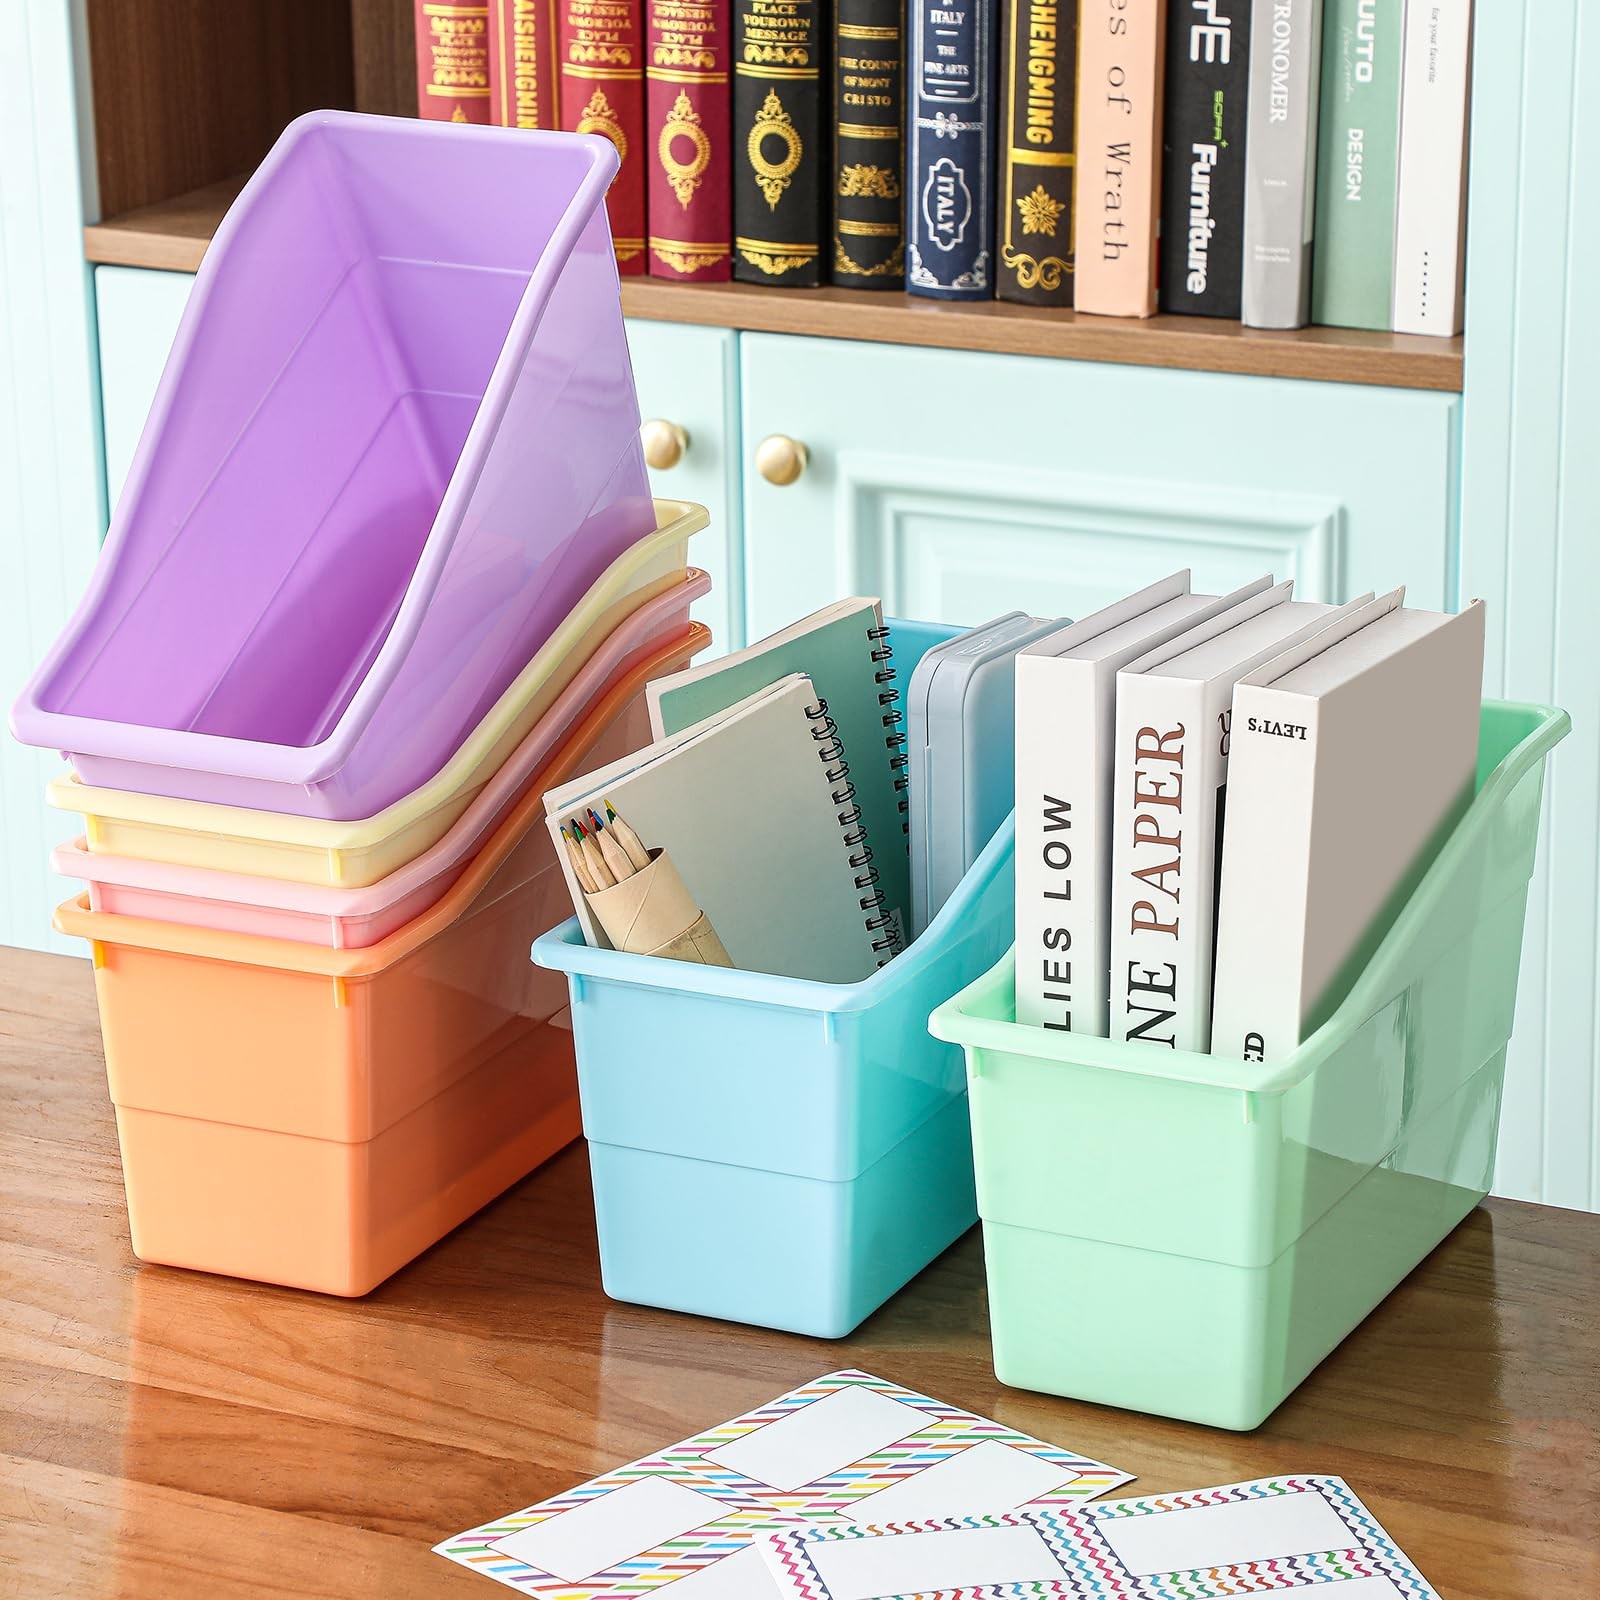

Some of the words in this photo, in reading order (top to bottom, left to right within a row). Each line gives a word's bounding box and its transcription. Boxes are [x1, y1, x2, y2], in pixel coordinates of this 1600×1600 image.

[577, 29, 619, 41] PLACE
[745, 28, 807, 41] MESSAGE
[752, 3, 797, 14] PLACE
[930, 9, 966, 26] ITALY
[661, 32, 703, 45] PLACE
[1107, 66, 1132, 114] of
[1346, 127, 1364, 201] DESIGN
[936, 175, 954, 235] ITALY
[1103, 143, 1131, 261] Wrath
[1187, 142, 1217, 294] Furniture
[1247, 717, 1308, 741] LEVI'S
[1043, 794, 1072, 901] LOW
[1131, 721, 1186, 941] PAPER
[1043, 927, 1072, 1032] LIES
